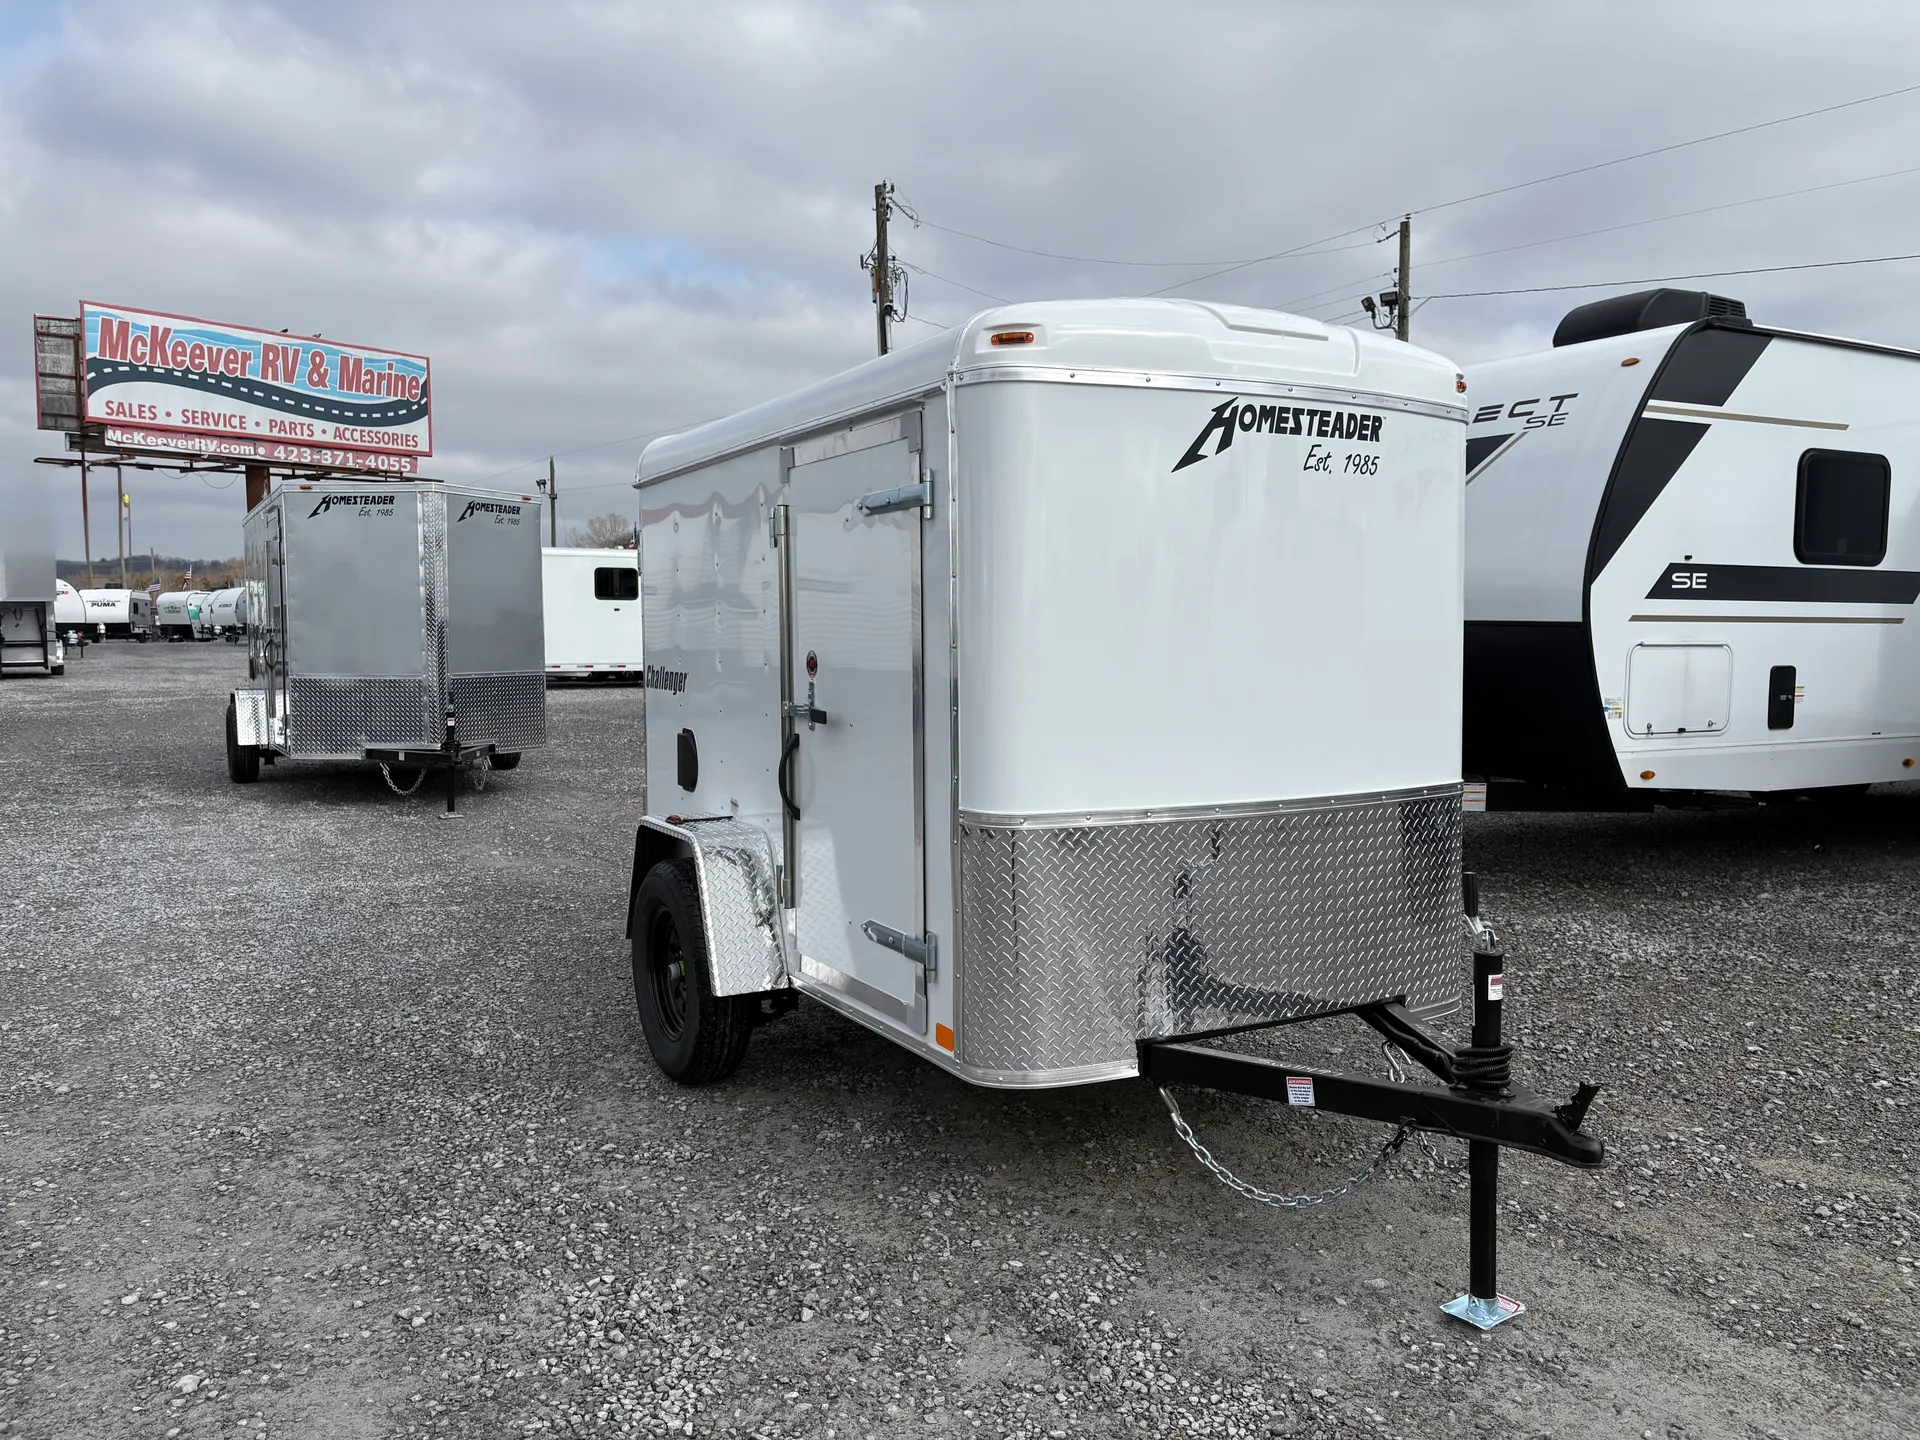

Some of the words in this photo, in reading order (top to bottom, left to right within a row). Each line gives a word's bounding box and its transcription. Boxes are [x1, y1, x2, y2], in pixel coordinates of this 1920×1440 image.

[98, 317, 252, 378] McKeever
[260, 342, 301, 384] RV
[307, 349, 330, 389] &
[338, 355, 421, 401] Marine
[105, 400, 157, 421] SALES
[181, 408, 247, 430] SERVICE
[269, 418, 315, 438] PARTS
[333, 426, 419, 448] ACCESSORIES
[1170, 396, 1384, 474] HOMESTEADER
[1523, 412, 1569, 430] SE
[107, 429, 255, 455] McKeeverRV.com
[273, 445, 412, 472] 423-371-4055
[1303, 443, 1332, 475] Est.
[1343, 453, 1381, 476] 1985
[307, 493, 396, 519] HOMESTEADER
[376, 508, 394, 517] 1985
[457, 500, 521, 523] HOMESTEADER
[1671, 572, 1708, 589] SE
[646, 664, 688, 696] Challenger
